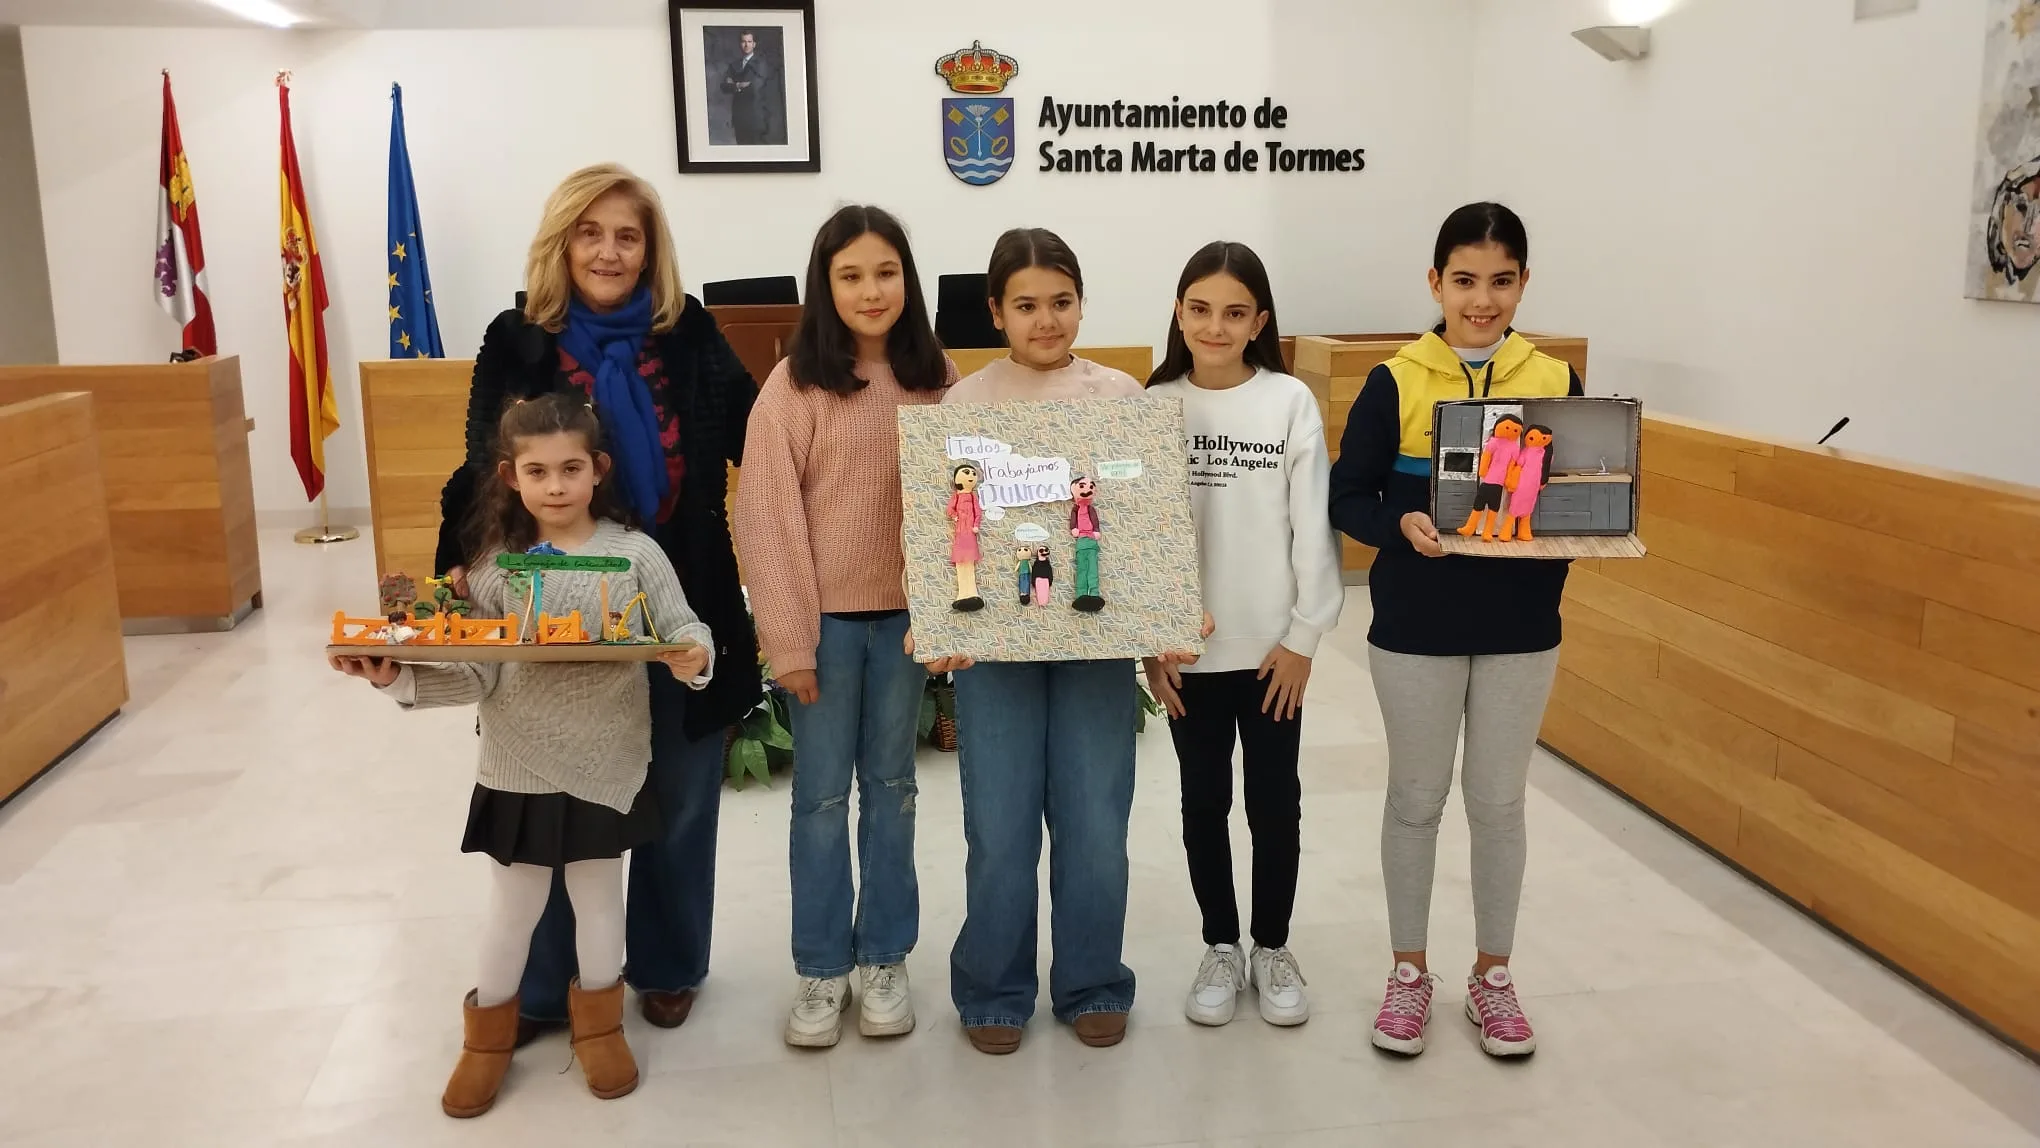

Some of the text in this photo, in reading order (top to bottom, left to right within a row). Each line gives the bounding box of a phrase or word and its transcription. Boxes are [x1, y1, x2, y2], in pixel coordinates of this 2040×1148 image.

[1039, 96, 1288, 136] Ayuntamiento de
[1039, 140, 1366, 173] Santa Marta de Tormes
[1193, 435, 1285, 455] Hollywood
[979, 457, 1060, 481] Trabajamos
[1207, 454, 1228, 466] Los
[1230, 456, 1279, 471] Angeles
